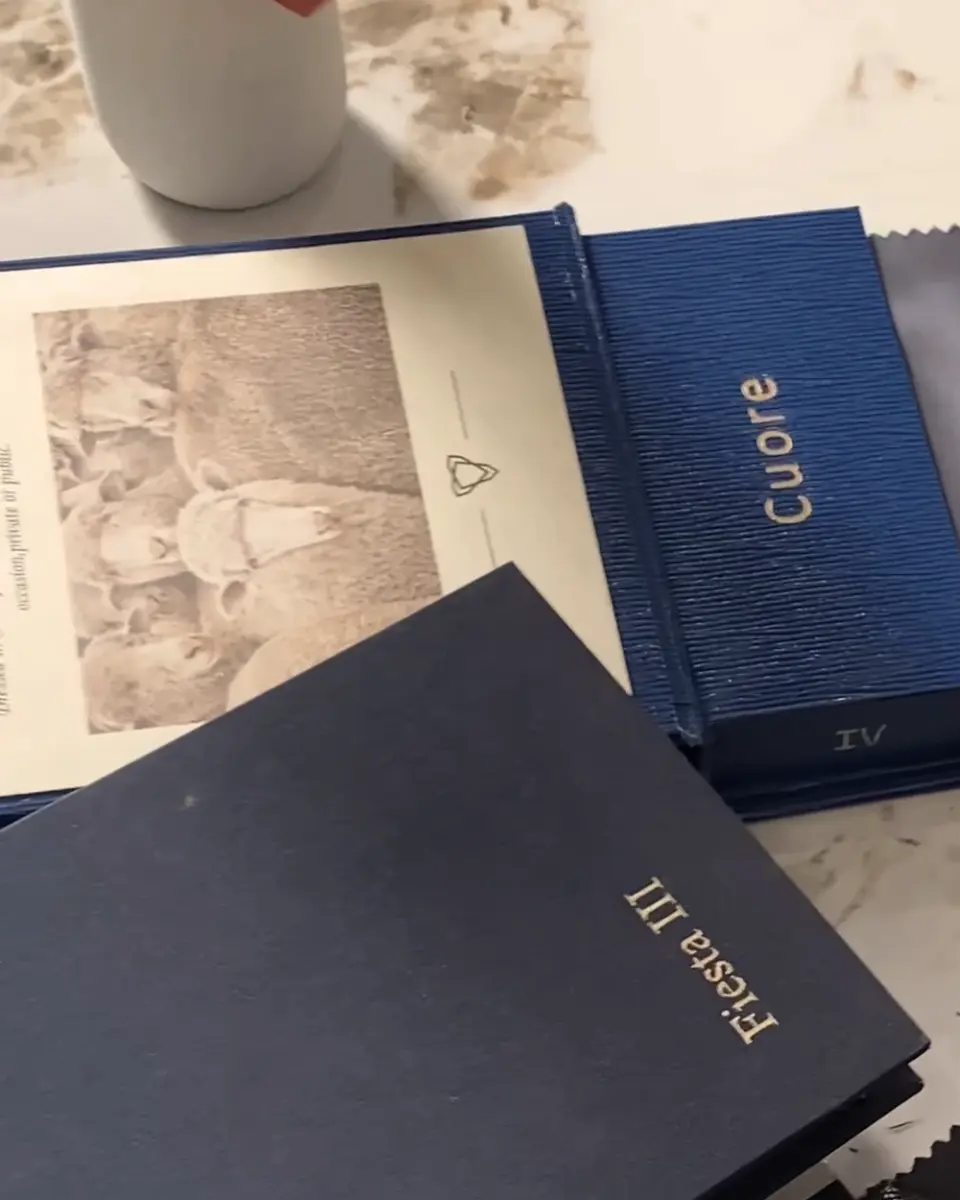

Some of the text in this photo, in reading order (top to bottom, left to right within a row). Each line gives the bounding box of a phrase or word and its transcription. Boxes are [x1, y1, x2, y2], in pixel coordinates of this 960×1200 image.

[740, 374, 813, 524] Cuore
[833, 723, 888, 751] IV
[624, 876, 779, 1044] Fiesta III
